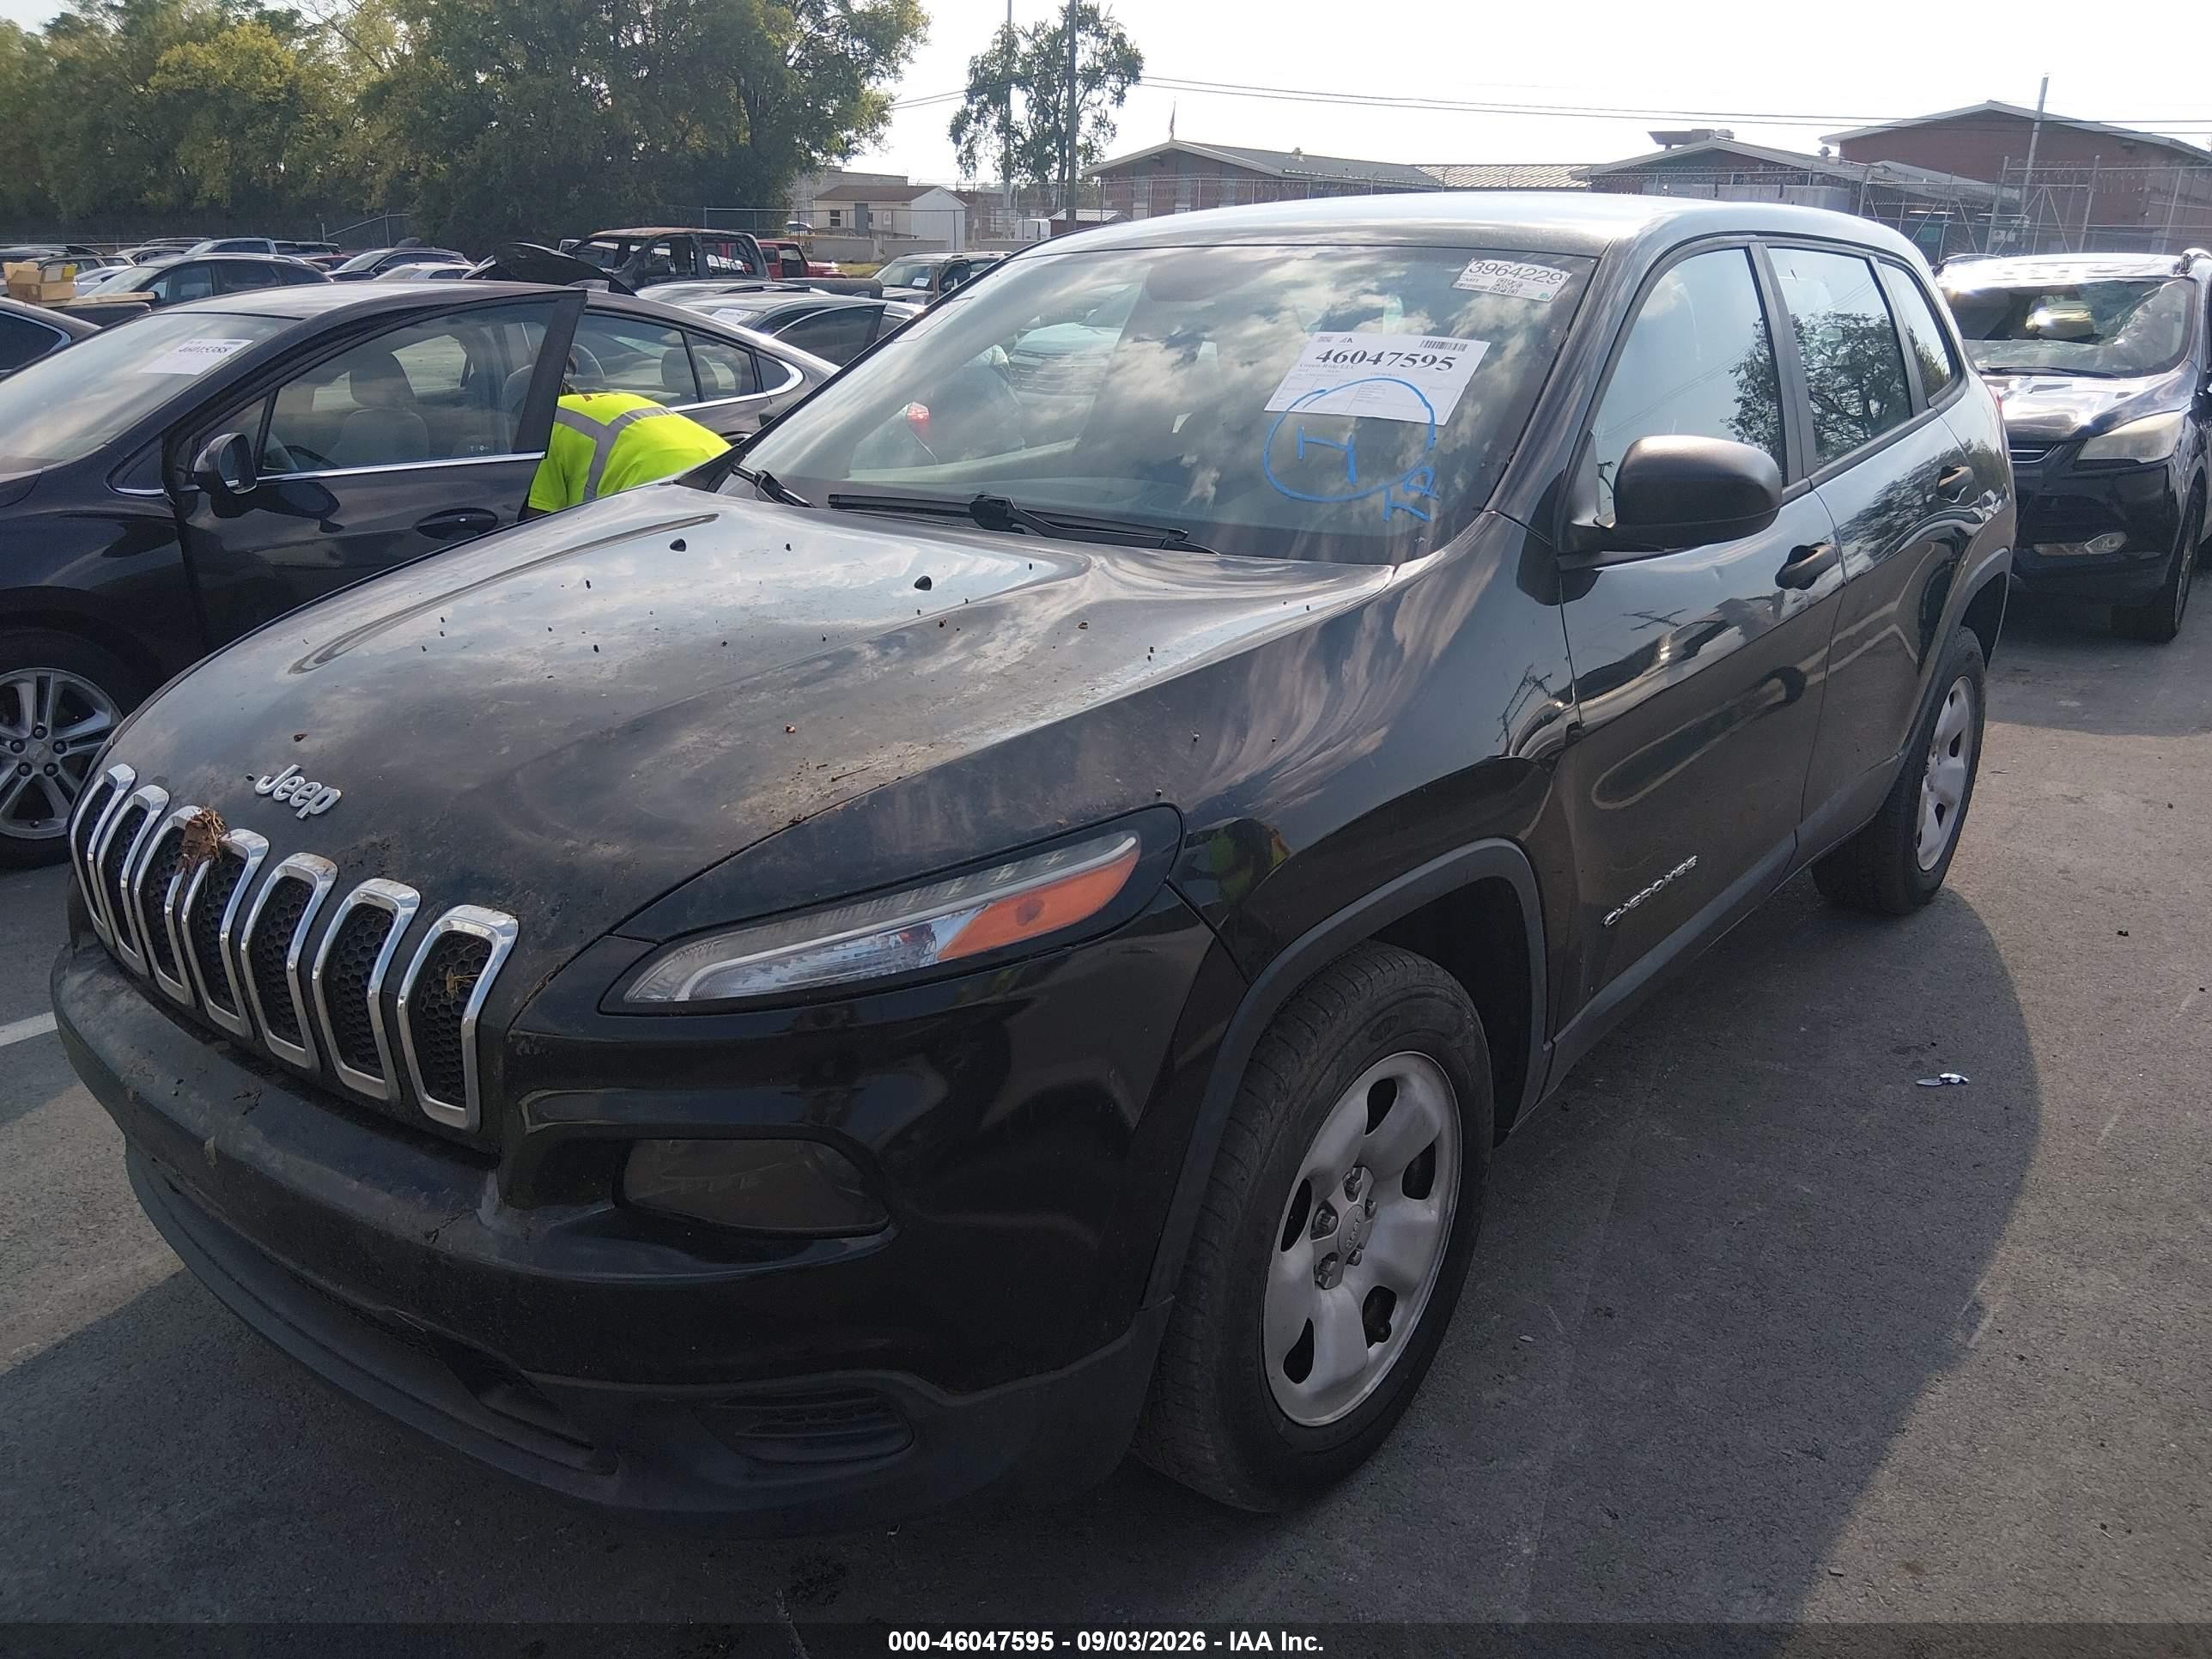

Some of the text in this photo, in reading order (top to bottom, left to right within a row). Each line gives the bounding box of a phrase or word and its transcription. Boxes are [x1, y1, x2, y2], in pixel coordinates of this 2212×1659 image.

[1468, 261, 1563, 284] 3964229
[1316, 349, 1456, 372] 46047595
[255, 763, 342, 819] Jeep
[1603, 855, 1698, 927] CHEROKEE
